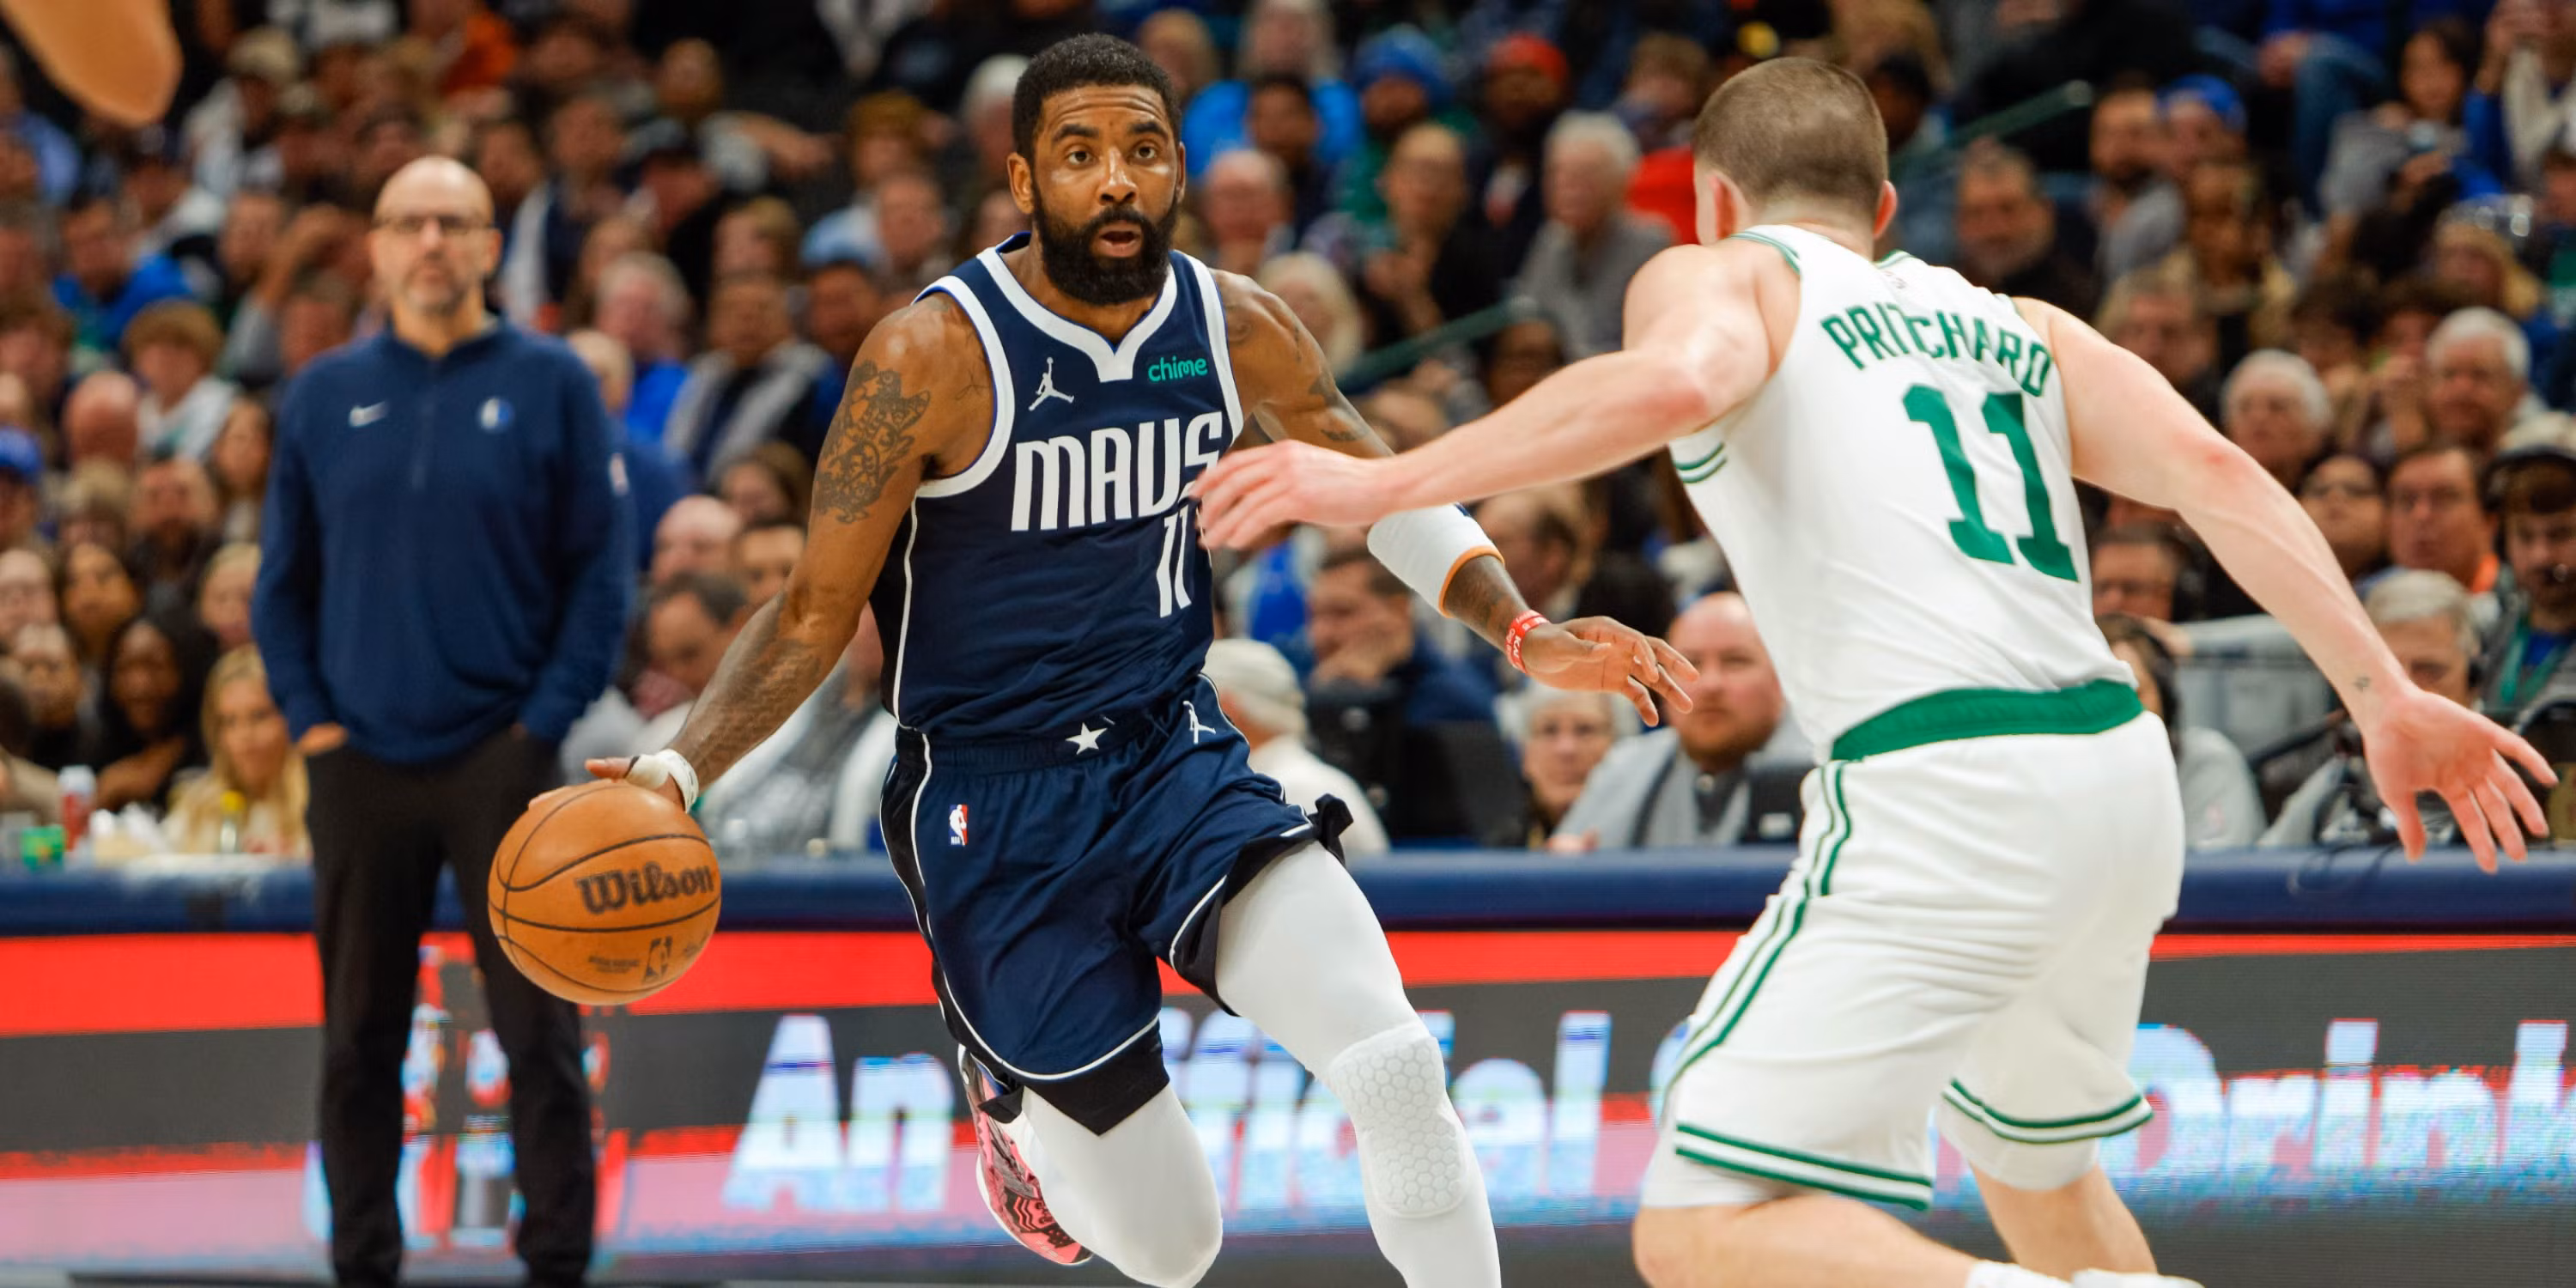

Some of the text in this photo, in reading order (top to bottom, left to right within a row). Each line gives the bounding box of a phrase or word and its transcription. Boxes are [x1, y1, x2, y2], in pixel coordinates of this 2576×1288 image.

[1148, 355, 1207, 382] chime
[1820, 303, 2053, 398] PRITCHARD
[1011, 411, 1223, 532] MAVS
[1902, 383, 2080, 583] 11
[1156, 504, 1192, 618] 11
[574, 861, 714, 915] Wilson
[721, 1012, 955, 1212] An
